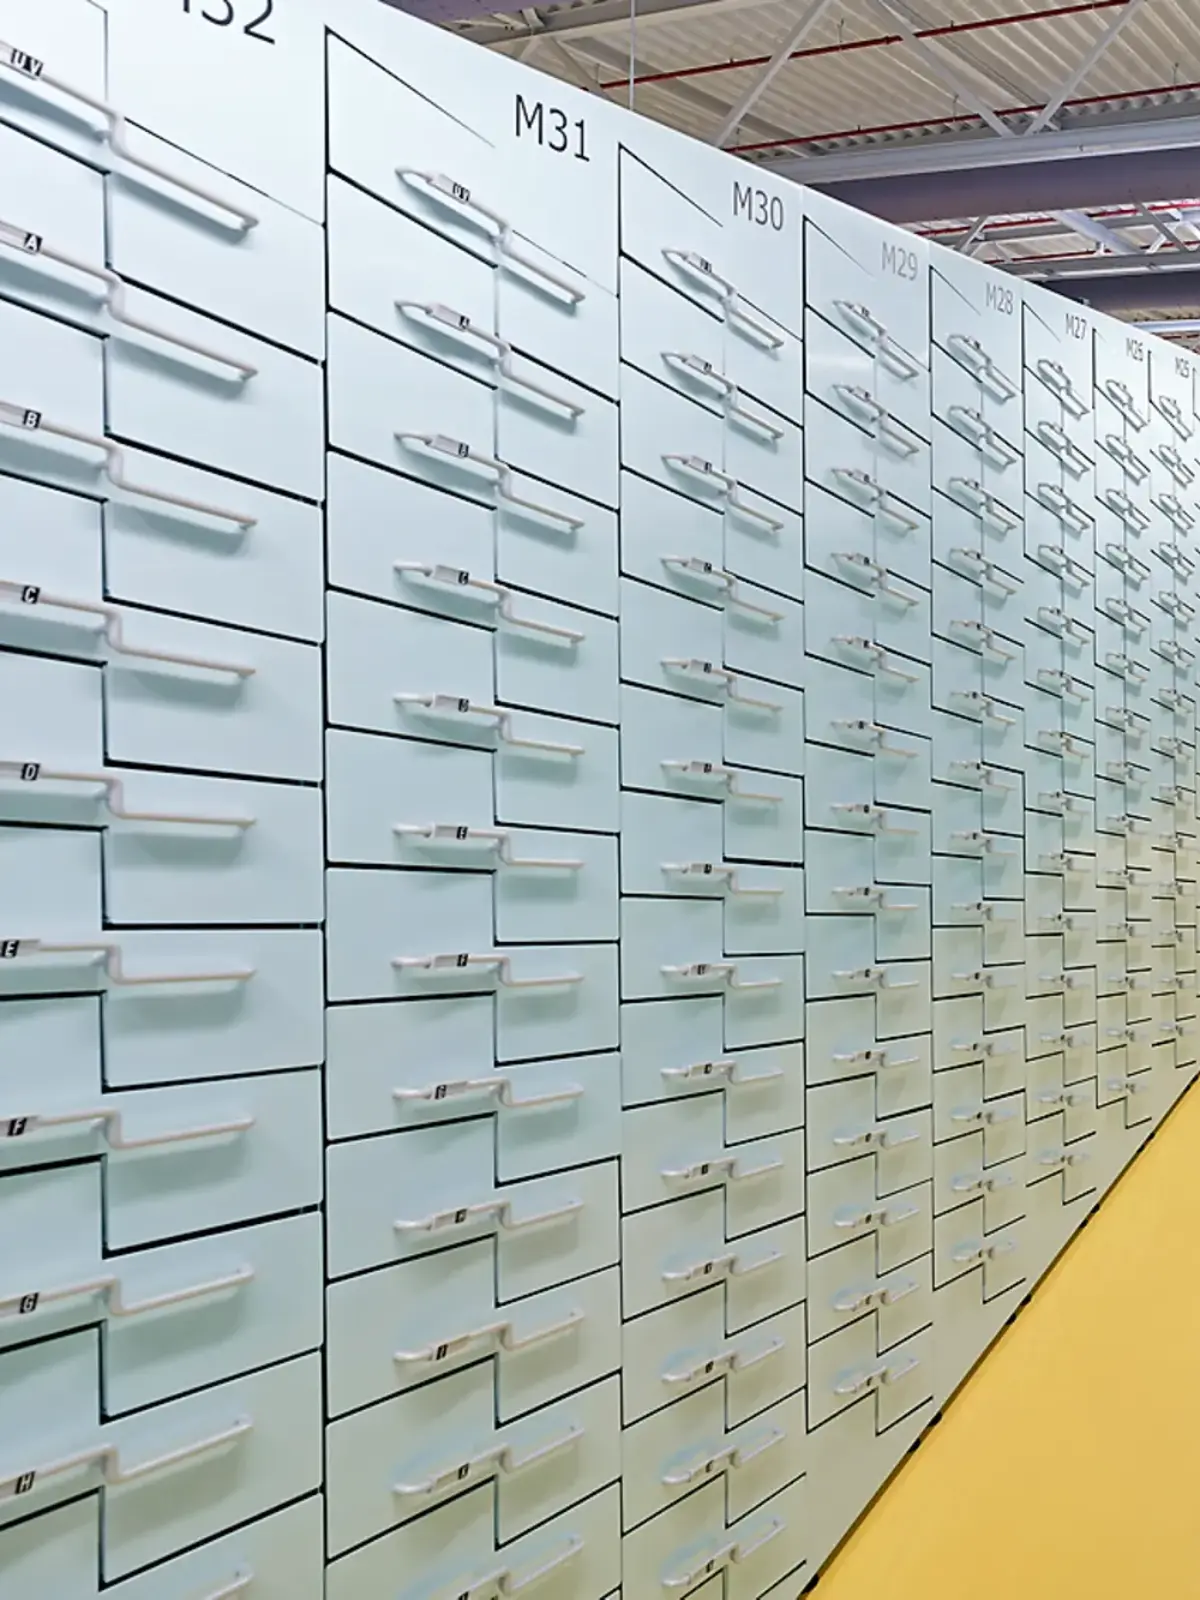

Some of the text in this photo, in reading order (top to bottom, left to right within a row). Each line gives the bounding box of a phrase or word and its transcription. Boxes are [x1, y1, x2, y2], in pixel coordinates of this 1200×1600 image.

[515, 94, 590, 162] M31
[733, 181, 784, 231] M30
[25, 233, 42, 252] A
[882, 242, 918, 281] M29
[986, 282, 1014, 315] M28
[1065, 313, 1088, 340] M27
[24, 410, 42, 429] B
[22, 586, 40, 604] C
[21, 762, 40, 781] D
[2, 939, 19, 958] E
[8, 1117, 26, 1137] F
[20, 1293, 39, 1314] G
[15, 1471, 36, 1494] H
